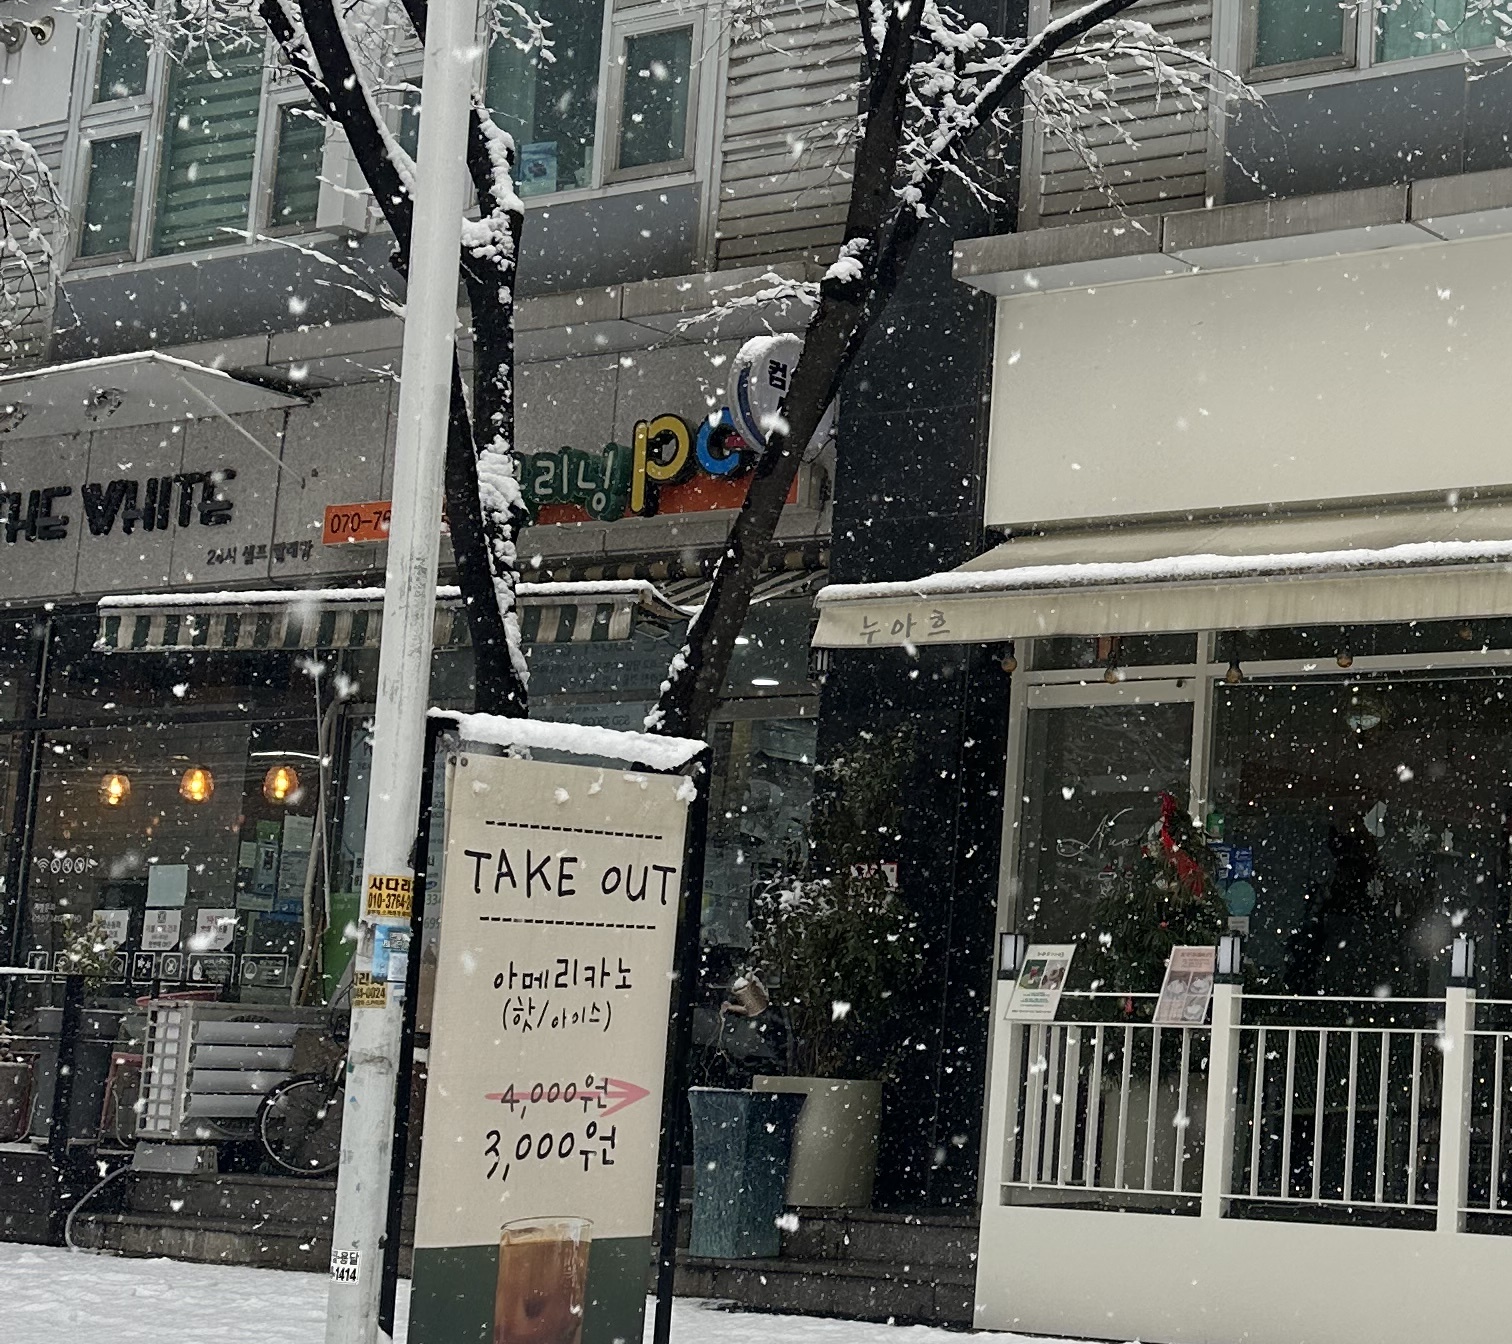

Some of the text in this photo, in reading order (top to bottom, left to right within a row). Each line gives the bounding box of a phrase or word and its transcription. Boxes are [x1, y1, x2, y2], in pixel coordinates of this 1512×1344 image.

[0, 469, 237, 544] HE WHITE
[860, 609, 950, 645] 누아흐
[464, 848, 677, 905] TAKE OUT
[493, 957, 632, 991] 아메리카노
[500, 1074, 609, 1120] 4,000원
[484, 1121, 617, 1182] 3,000원
